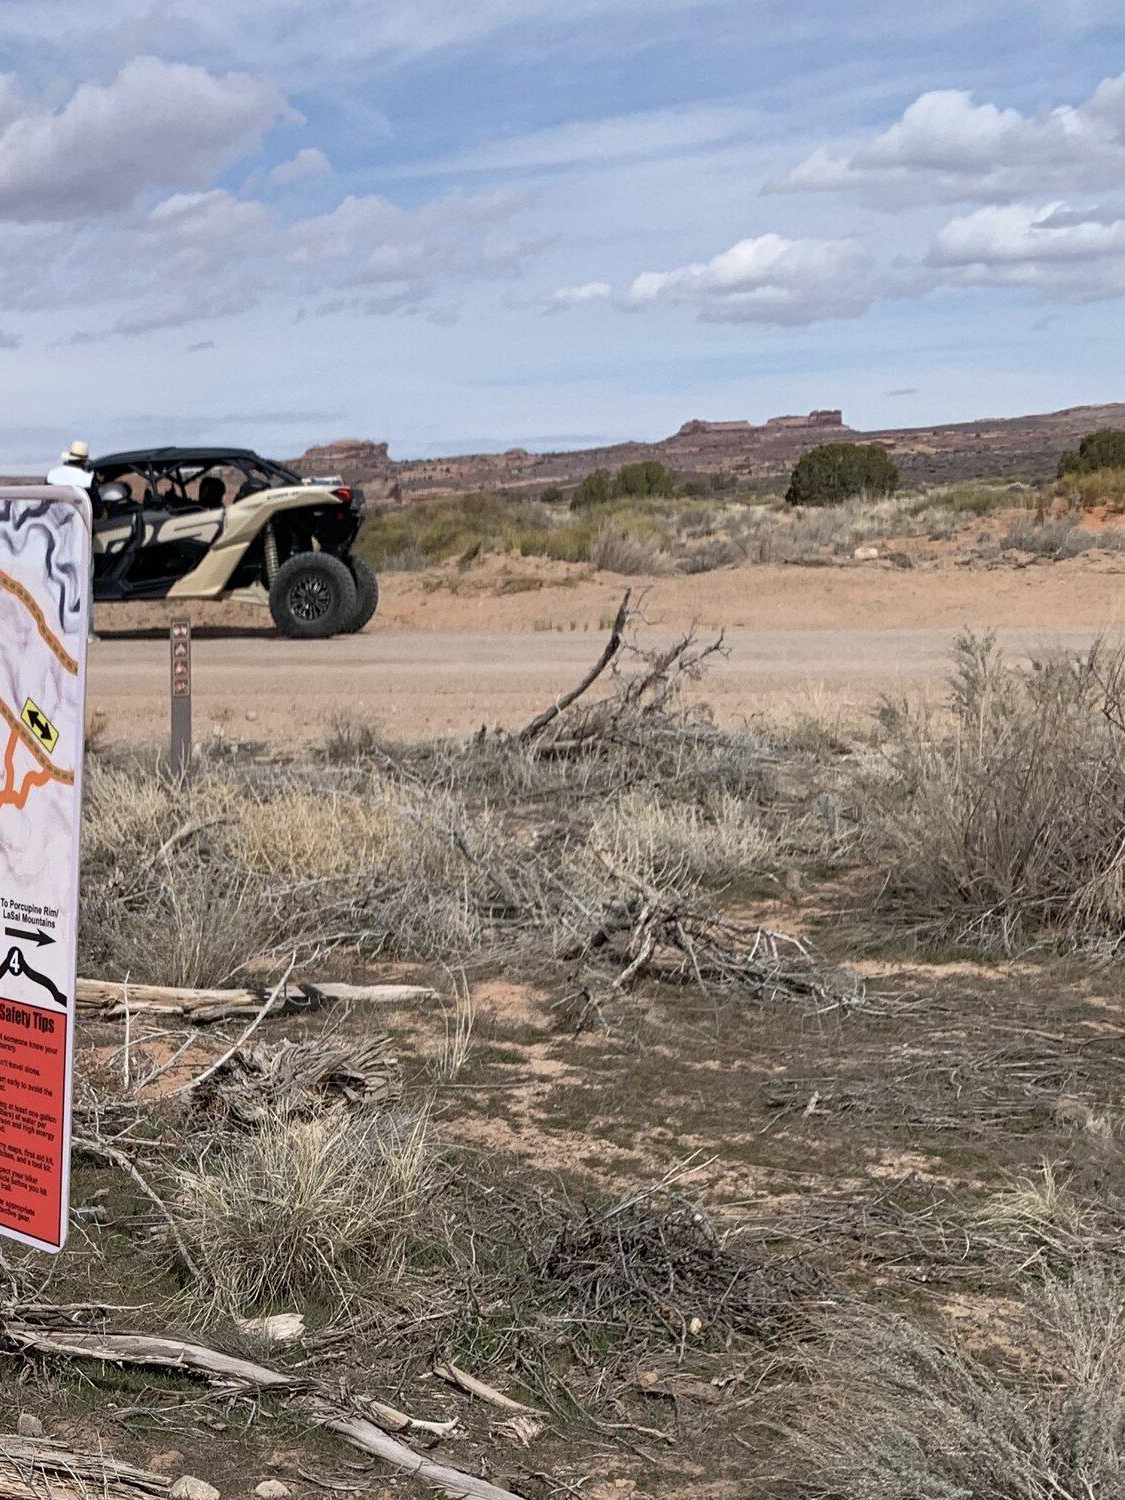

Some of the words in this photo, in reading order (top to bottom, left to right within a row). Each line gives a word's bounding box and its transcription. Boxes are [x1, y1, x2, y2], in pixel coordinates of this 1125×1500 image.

[1, 898, 8, 908] To
[9, 900, 42, 917] Porcupine
[43, 906, 59, 919] Rim/
[2, 909, 22, 924] LaSal
[23, 912, 56, 929] Mountains
[10, 949, 20, 972] 4
[0, 1004, 30, 1028] Safety
[33, 1013, 54, 1033] Tips
[3, 1035, 28, 1046] someone
[28, 1041, 43, 1051] know
[44, 1046, 58, 1056] your
[8, 1061, 23, 1070] travel
